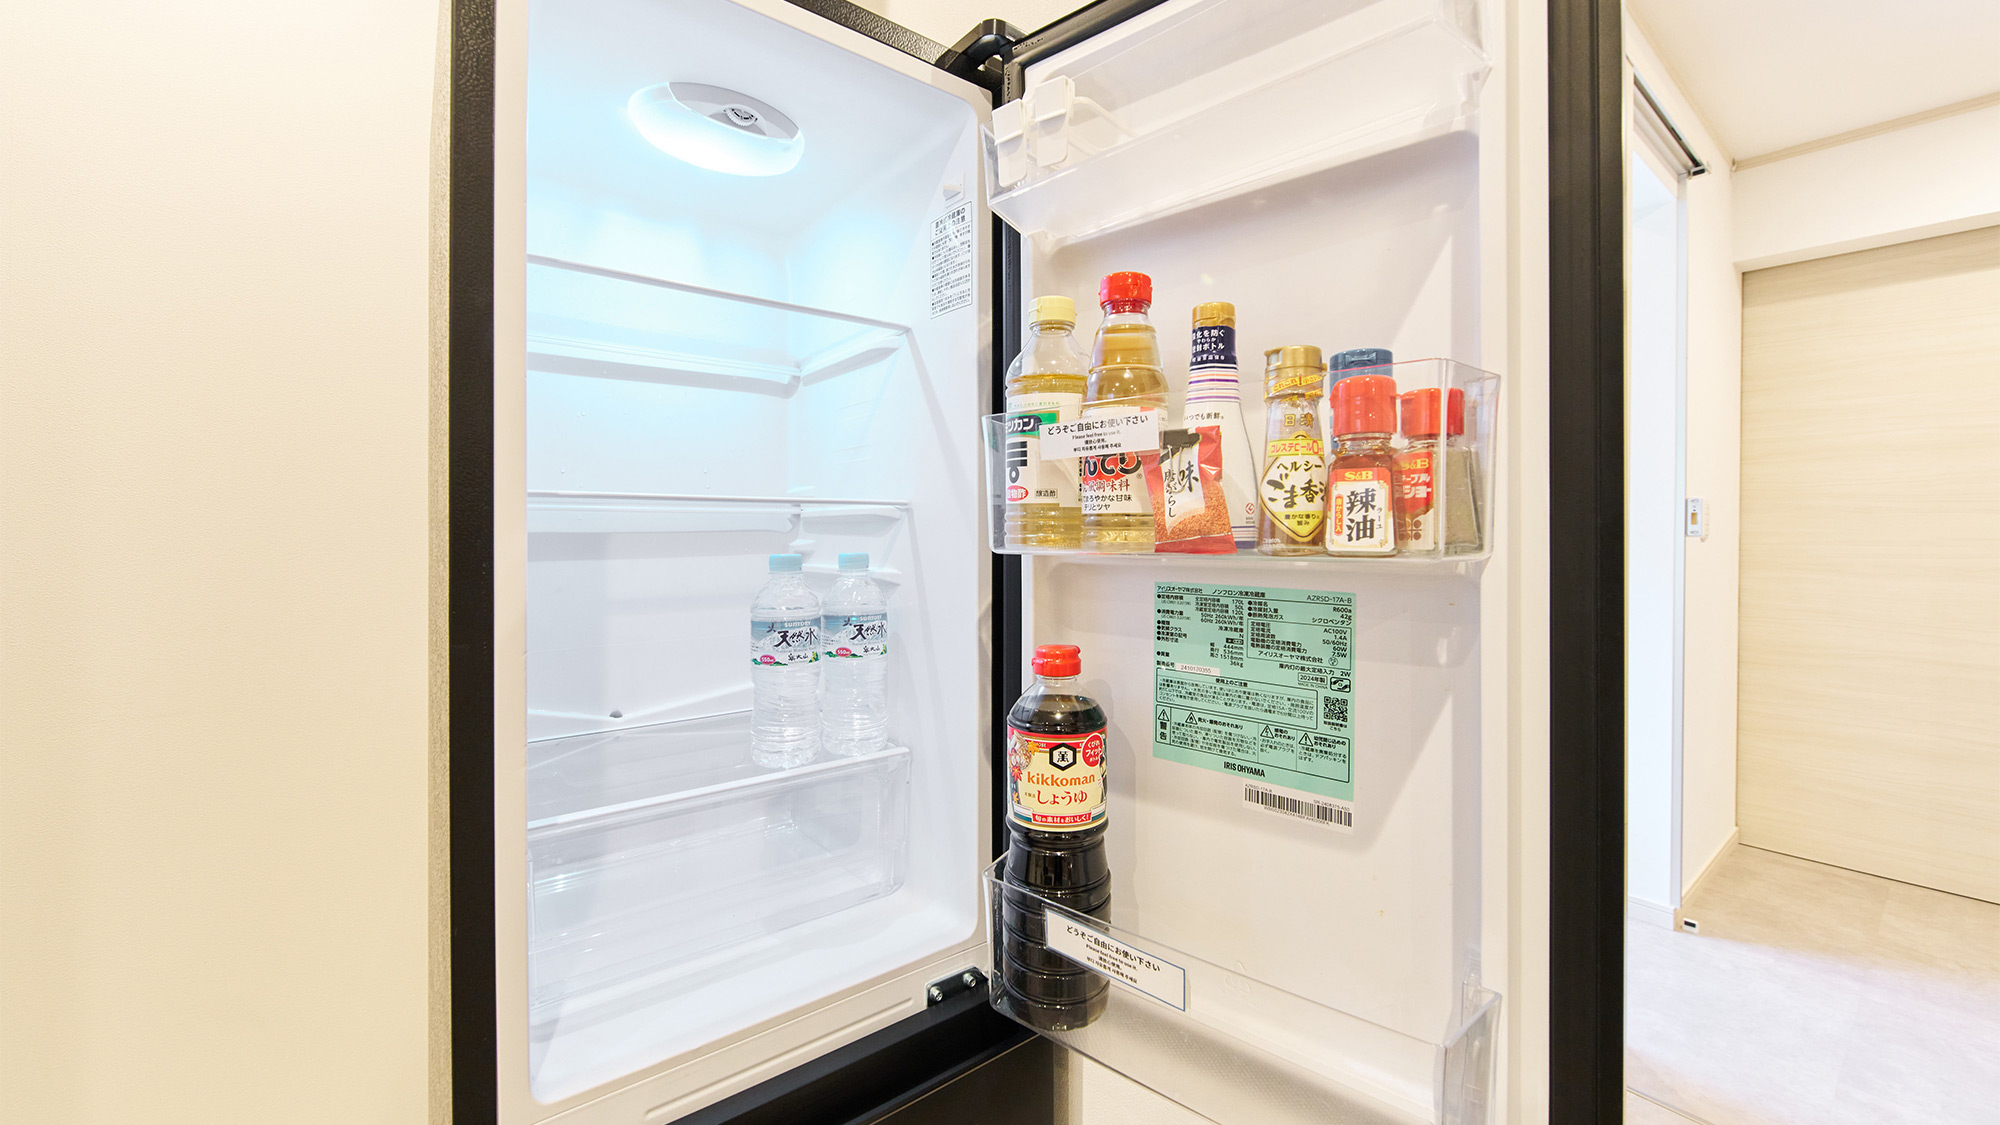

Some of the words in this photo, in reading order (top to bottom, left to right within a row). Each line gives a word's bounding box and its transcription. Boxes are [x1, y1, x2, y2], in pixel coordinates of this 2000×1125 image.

[1047, 415, 1149, 436] どうぞご自由にお使い下さい
[1277, 461, 1322, 472] ヘルシー
[1344, 470, 1373, 481] S&B
[1404, 485, 1432, 498] ショー
[1346, 488, 1376, 542] 辣油
[774, 628, 818, 647] 天然水
[850, 621, 887, 640] 天然水
[1322, 639, 1347, 647] 50/60Hz
[1258, 650, 1324, 664] アイリスオーヤマ株式会社
[1300, 674, 1326, 683] 2024年製
[1223, 761, 1236, 771] IRIS
[1237, 765, 1265, 778] OHYAMA
[1027, 771, 1095, 787] kikkoman
[1037, 790, 1087, 806] しょうゆ
[1066, 925, 1160, 972] どうぞご自由にお使い下さい
